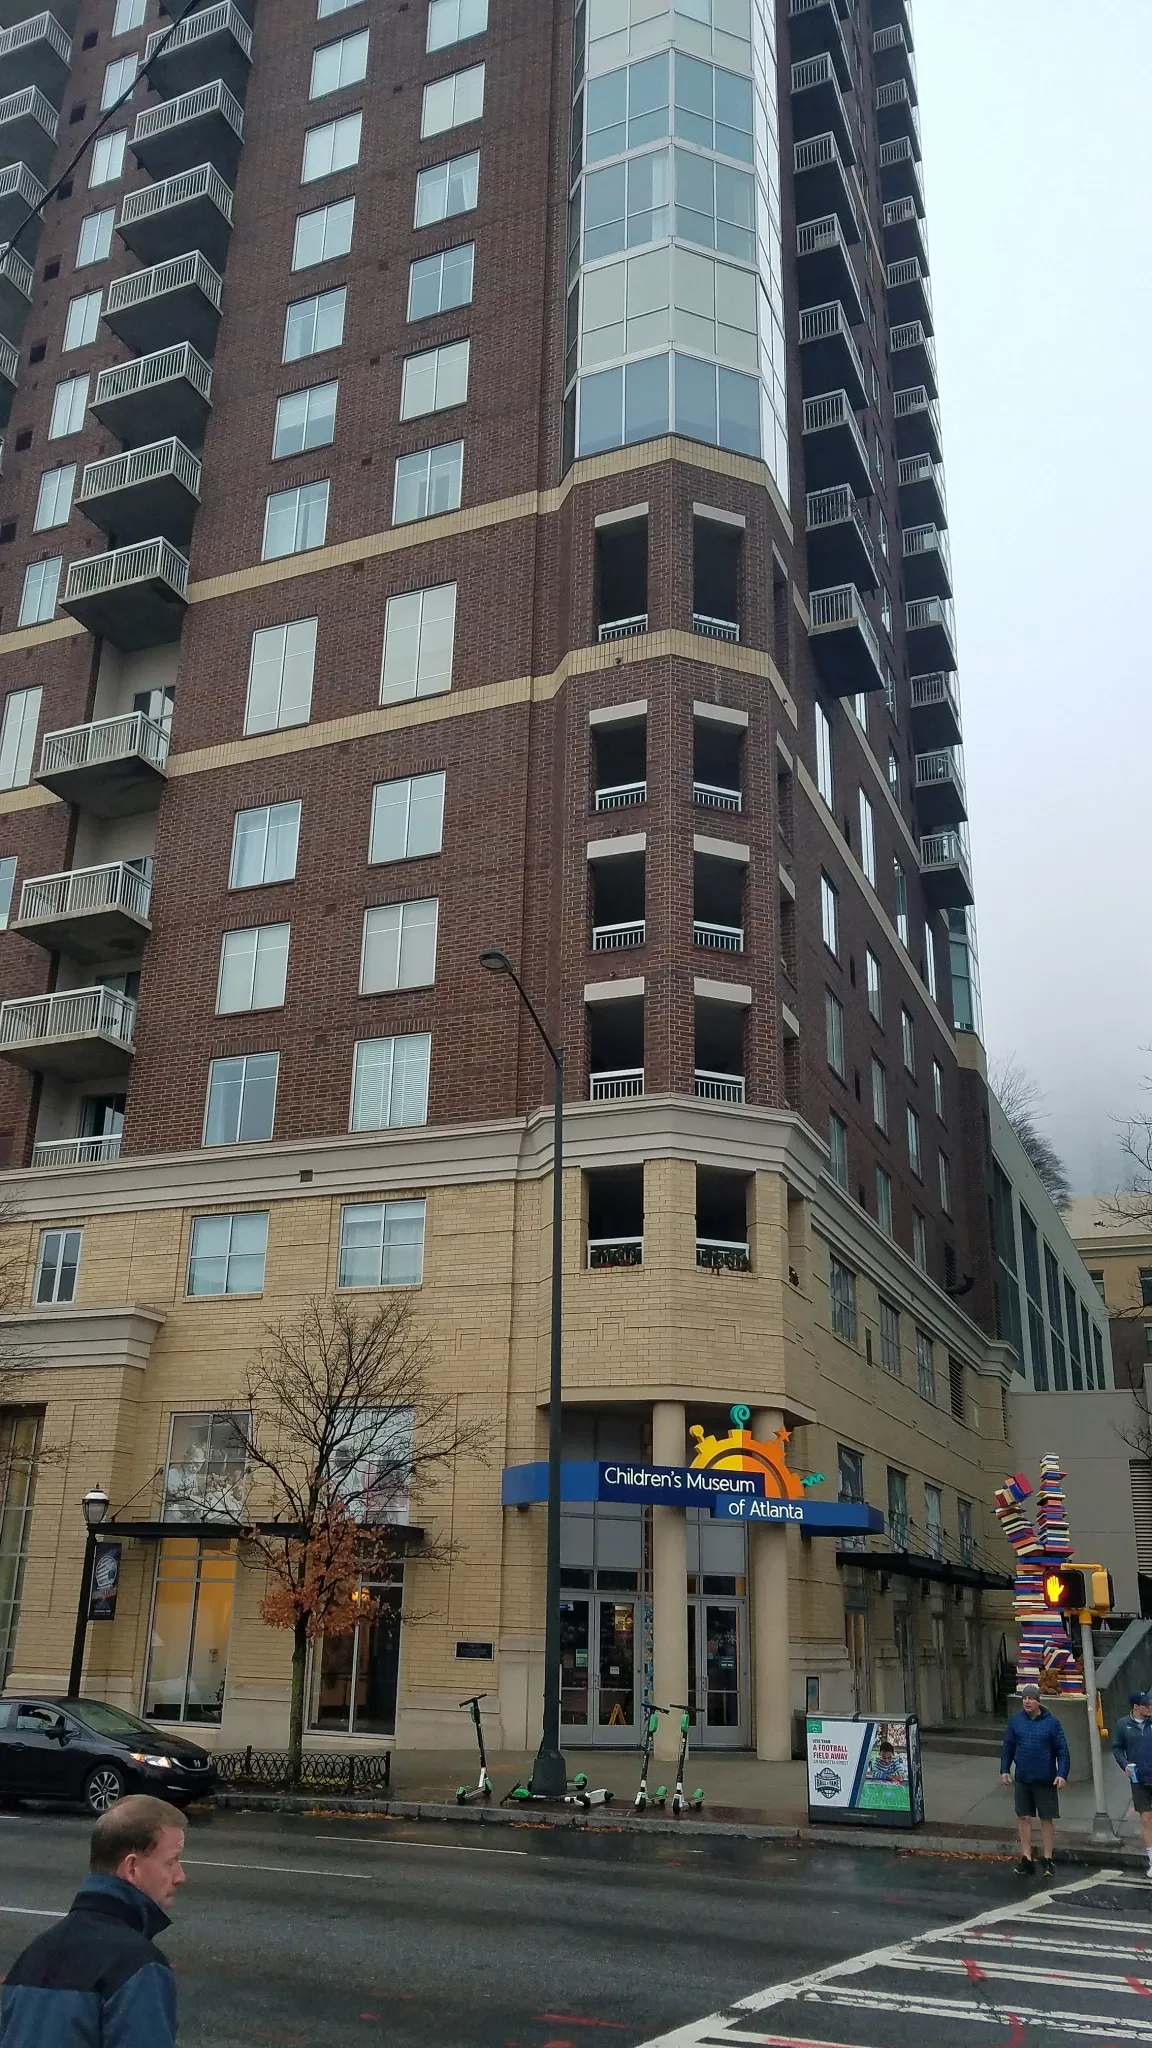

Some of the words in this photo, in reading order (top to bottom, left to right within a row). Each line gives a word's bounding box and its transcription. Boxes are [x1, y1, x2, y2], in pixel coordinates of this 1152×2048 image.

[604, 1467, 682, 1489] Children's
[686, 1472, 756, 1493] Museum
[728, 1499, 745, 1516] of
[749, 1501, 804, 1520] Atlanta
[818, 1744, 848, 1752] FOOTBALL
[830, 1752, 848, 1760] AWAY
